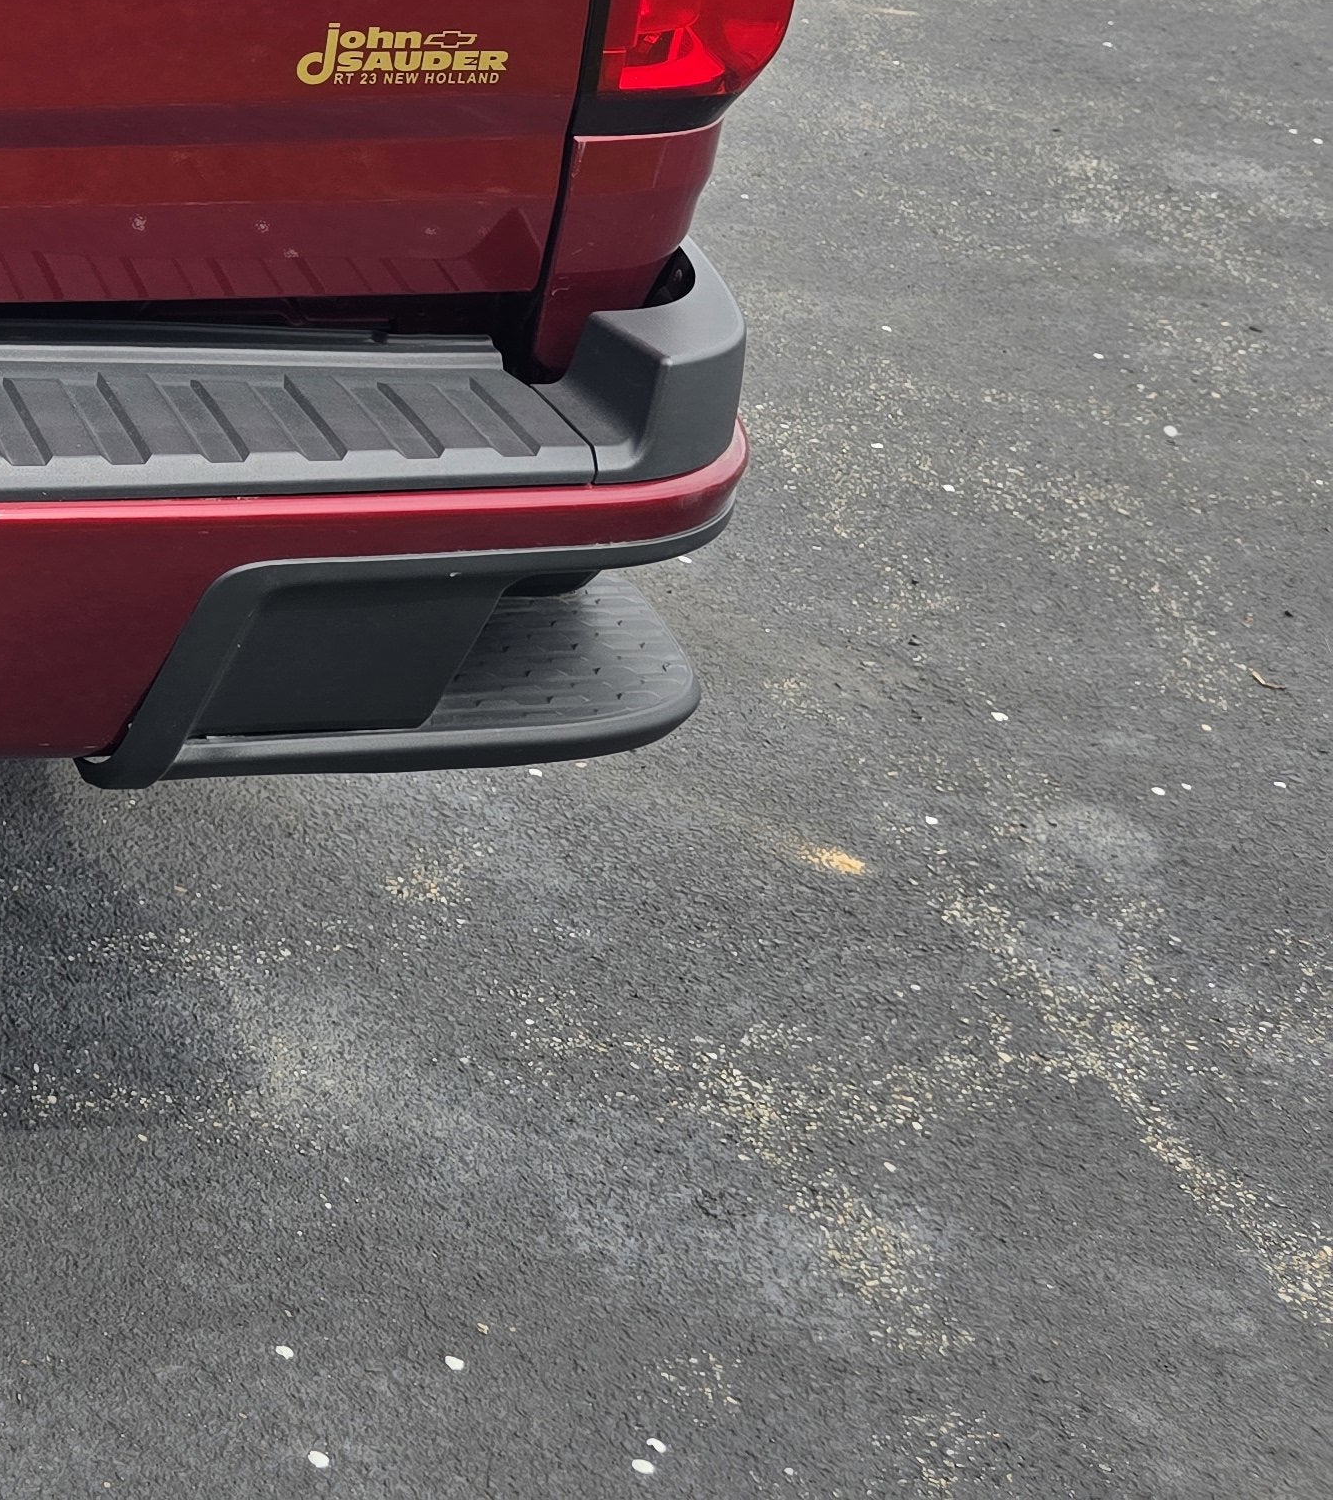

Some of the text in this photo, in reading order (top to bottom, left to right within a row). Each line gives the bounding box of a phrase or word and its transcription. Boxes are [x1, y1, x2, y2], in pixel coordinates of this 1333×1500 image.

[296, 22, 422, 85] john
[336, 50, 509, 72] SAUDER
[333, 72, 500, 85] RT 23 NEW HOLLAND
